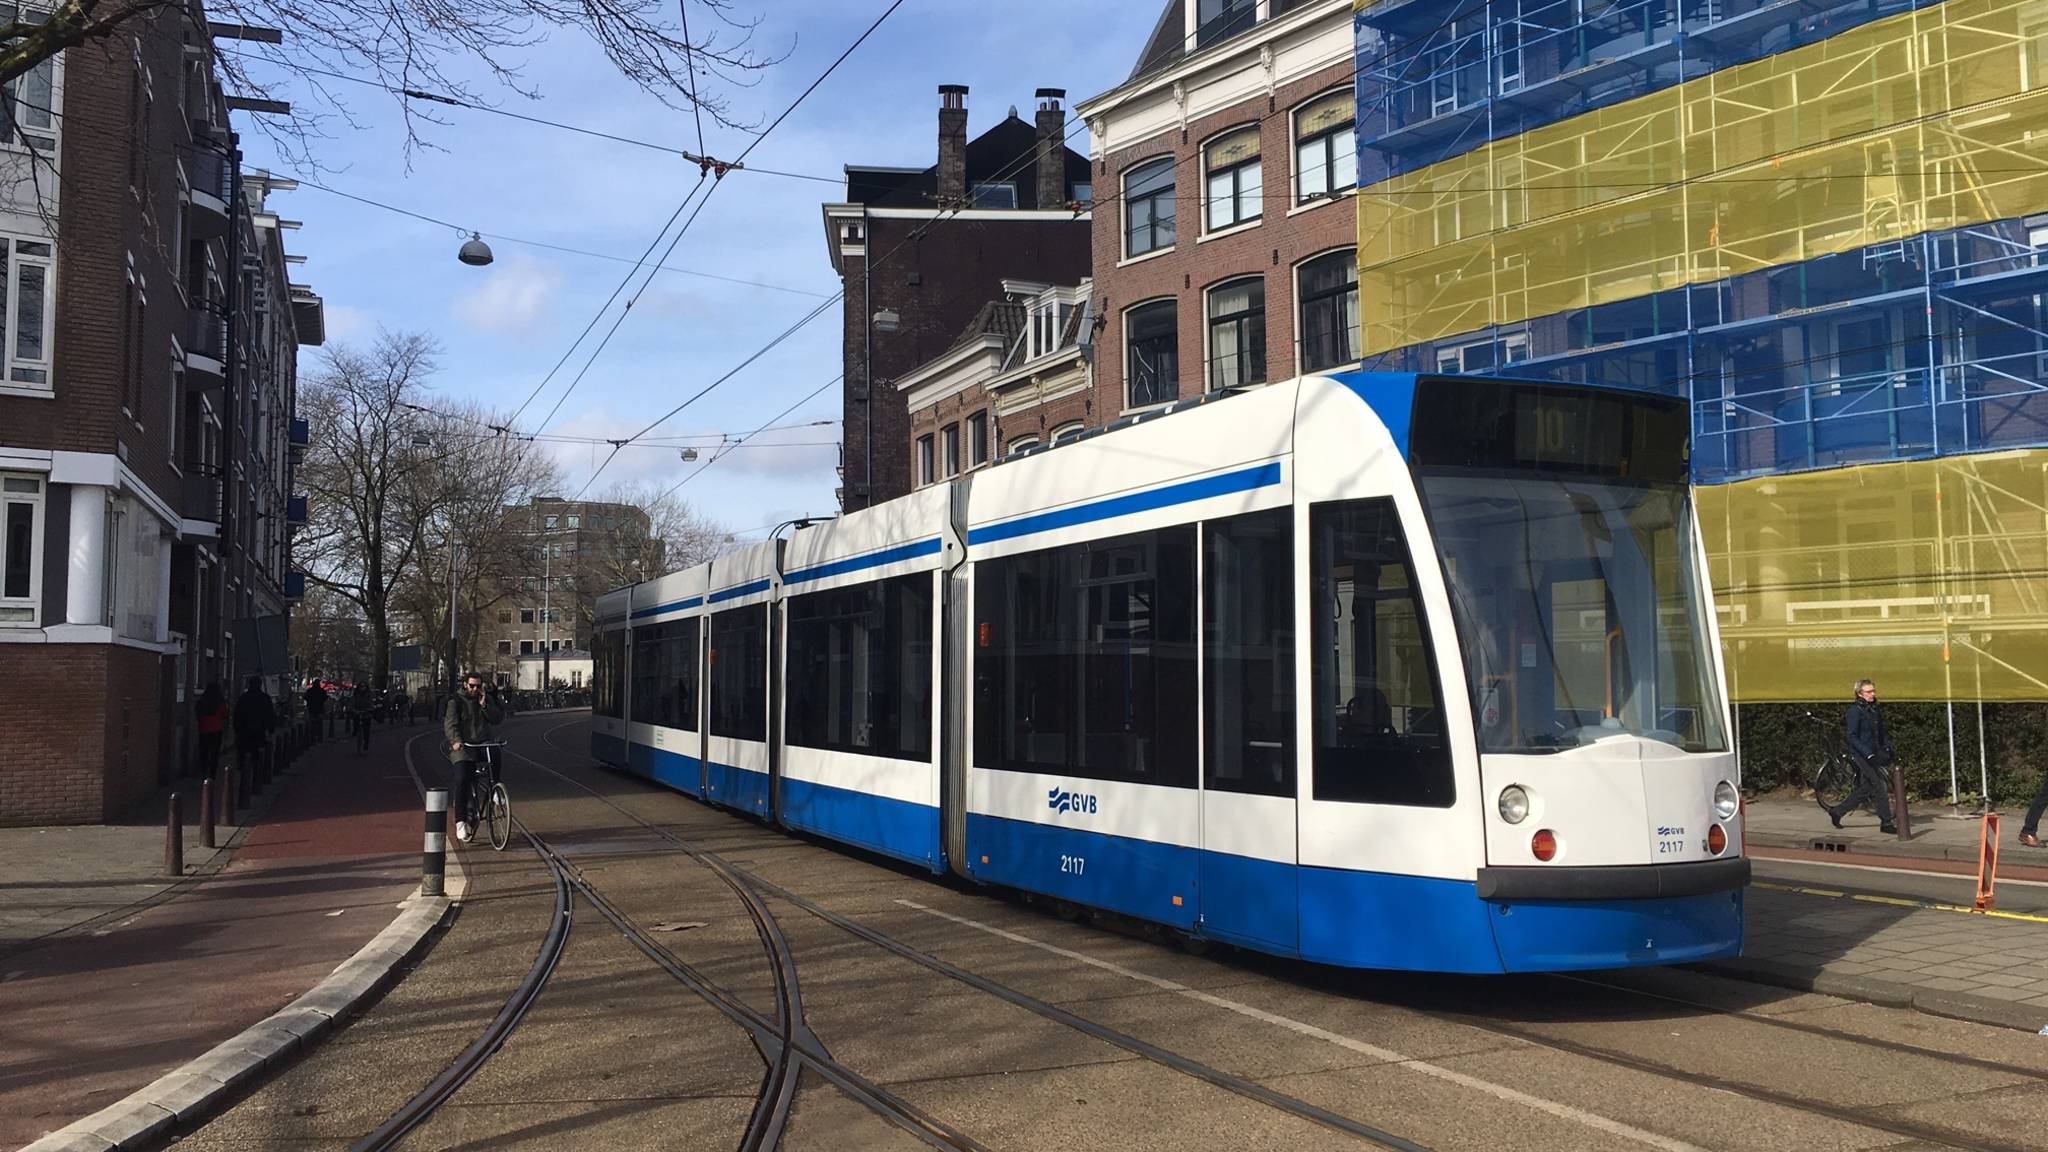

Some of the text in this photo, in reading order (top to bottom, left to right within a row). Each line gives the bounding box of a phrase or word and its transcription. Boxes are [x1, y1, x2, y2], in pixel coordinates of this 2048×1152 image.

[1071, 793, 1097, 814] GVB
[1670, 827, 1685, 835] GVB
[1660, 841, 1684, 853] 2117
[1061, 854, 1085, 875] 2117
